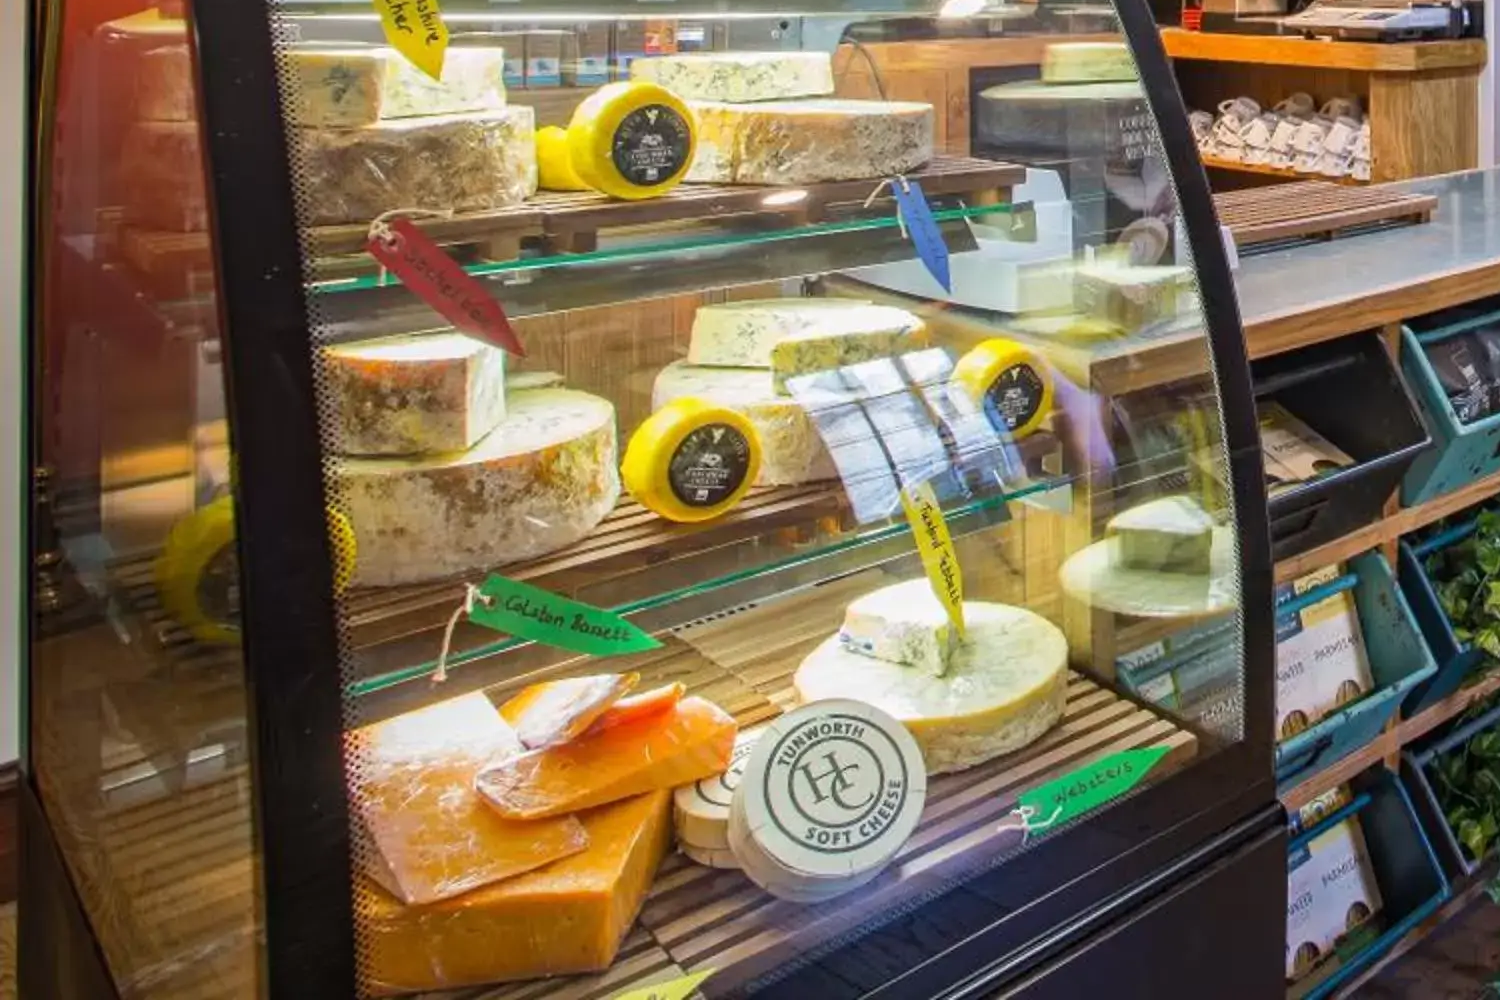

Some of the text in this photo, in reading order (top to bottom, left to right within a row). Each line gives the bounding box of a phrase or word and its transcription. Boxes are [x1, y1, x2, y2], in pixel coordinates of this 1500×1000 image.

[505, 595, 566, 629] Colston
[777, 722, 866, 768] TUNWORTH
[1055, 761, 1133, 804] Websters
[804, 777, 903, 845] SOFT CHEESE
